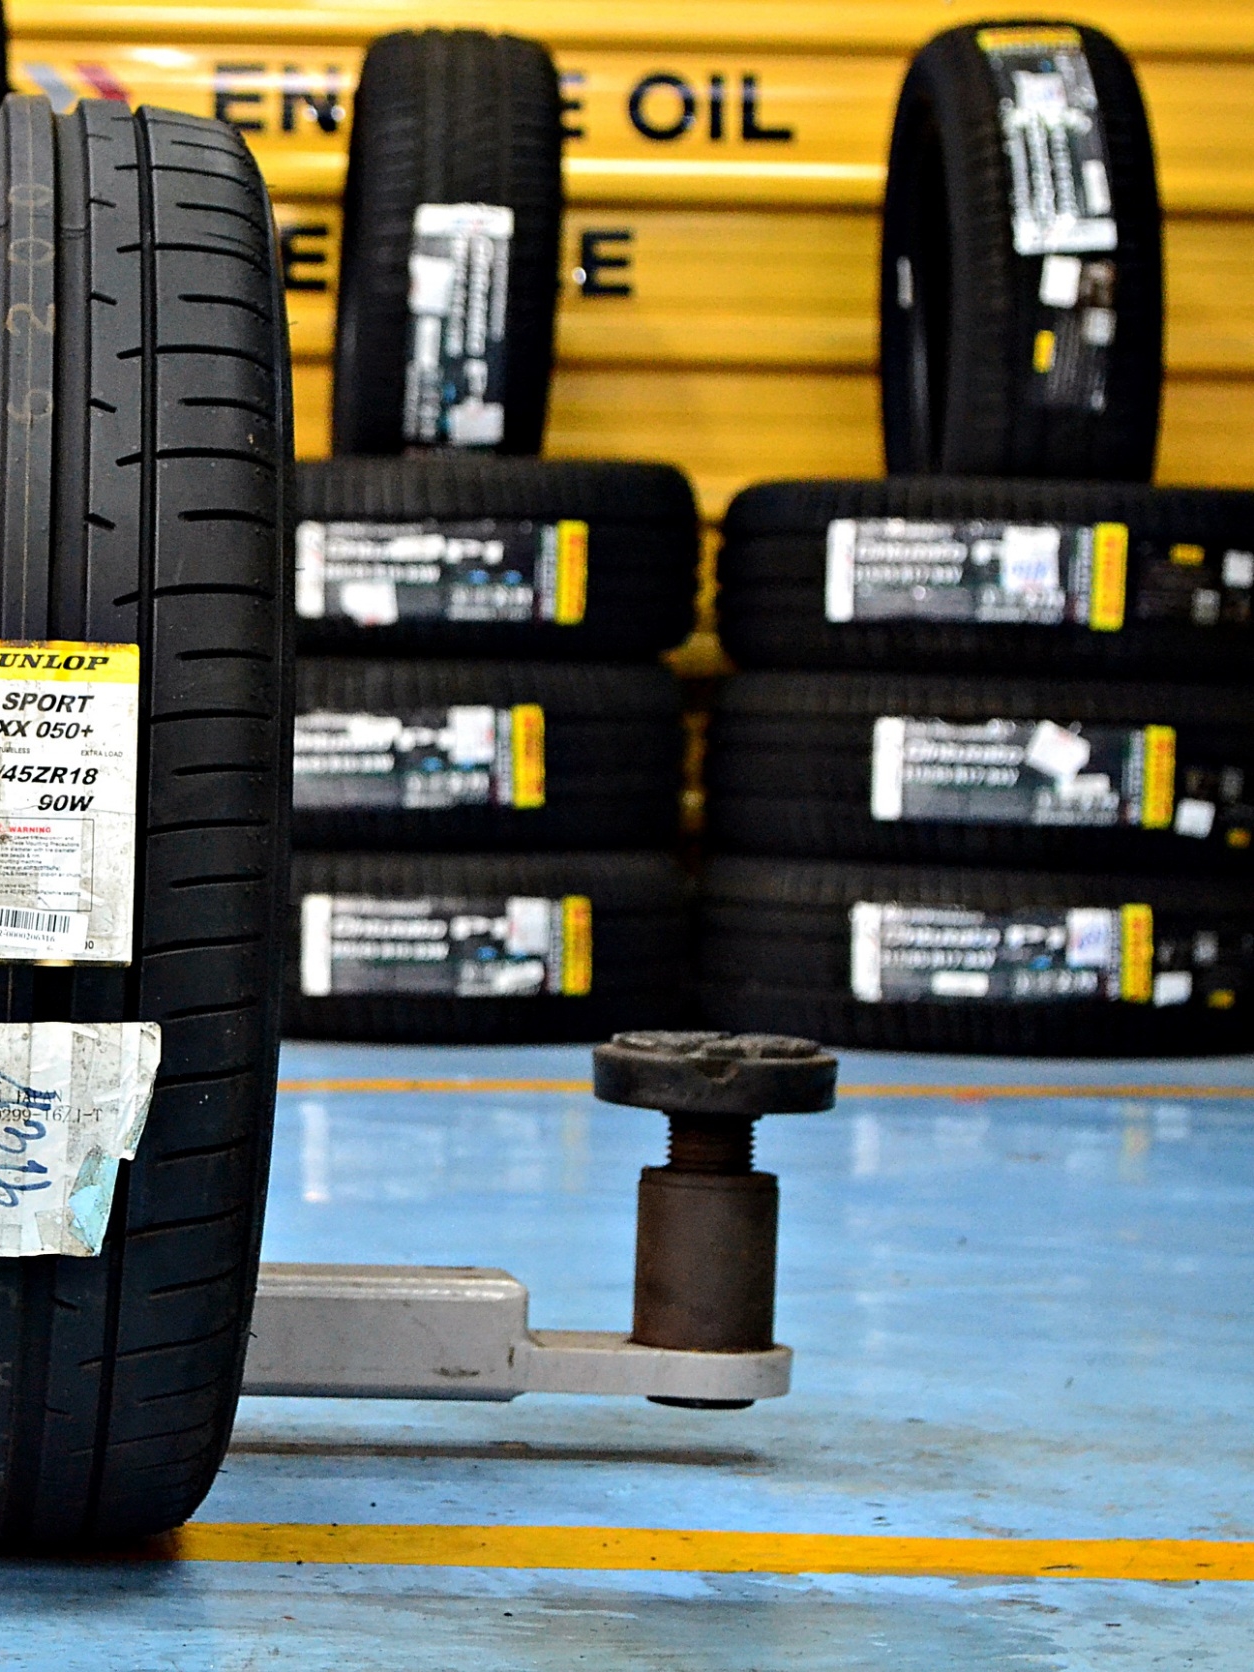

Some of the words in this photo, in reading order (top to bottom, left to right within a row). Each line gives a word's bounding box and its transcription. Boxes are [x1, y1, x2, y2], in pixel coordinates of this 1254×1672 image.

[628, 72, 794, 141] OIL
[2, 692, 94, 713] SPORT
[36, 721, 94, 739] 050+
[80, 749, 103, 757] EXTRA
[104, 750, 124, 758] LOAD
[37, 794, 94, 812] 90W
